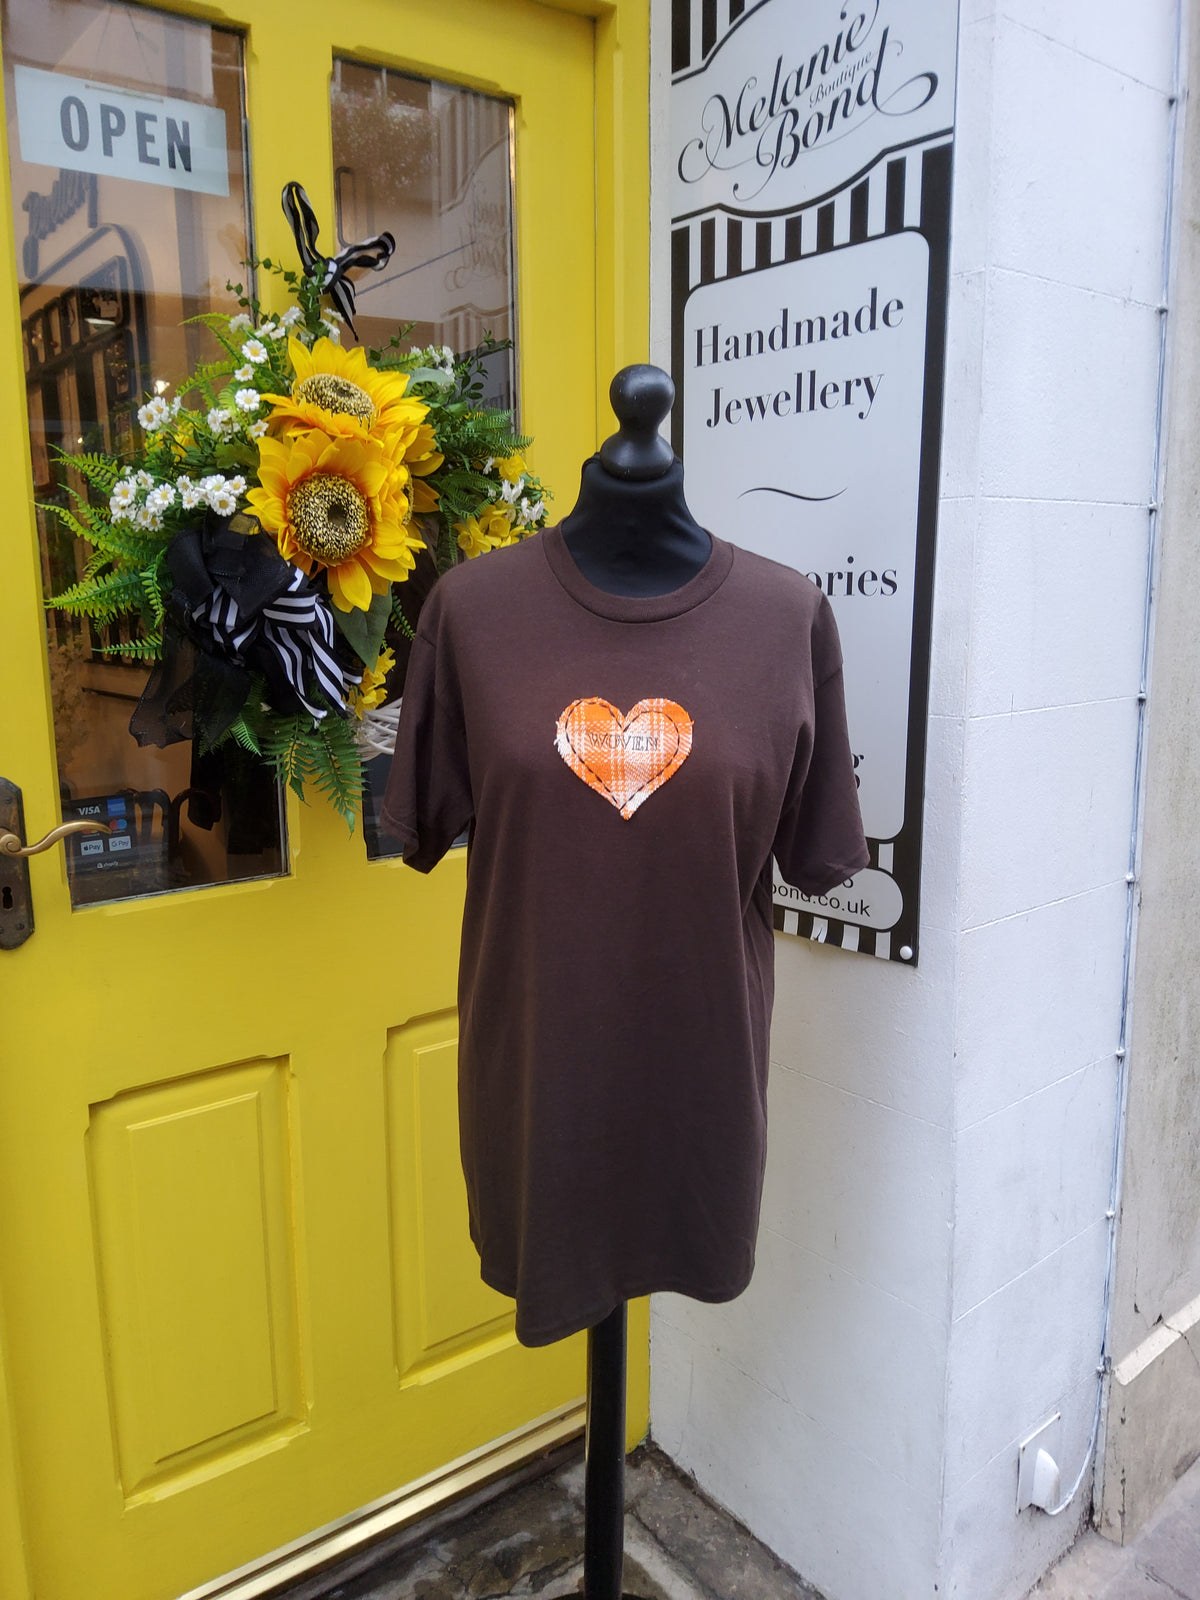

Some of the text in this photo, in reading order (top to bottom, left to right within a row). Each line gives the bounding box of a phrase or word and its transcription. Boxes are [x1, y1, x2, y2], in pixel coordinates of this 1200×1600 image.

[681, 1, 877, 174] Melanie
[736, 26, 931, 196] Bond
[809, 51, 872, 109] Boutique
[60, 95, 192, 173] OPEN
[693, 287, 904, 368] Handmade
[706, 370, 884, 428] Jewellery
[588, 732, 659, 751] WOVEN
[78, 806, 101, 816] VISA
